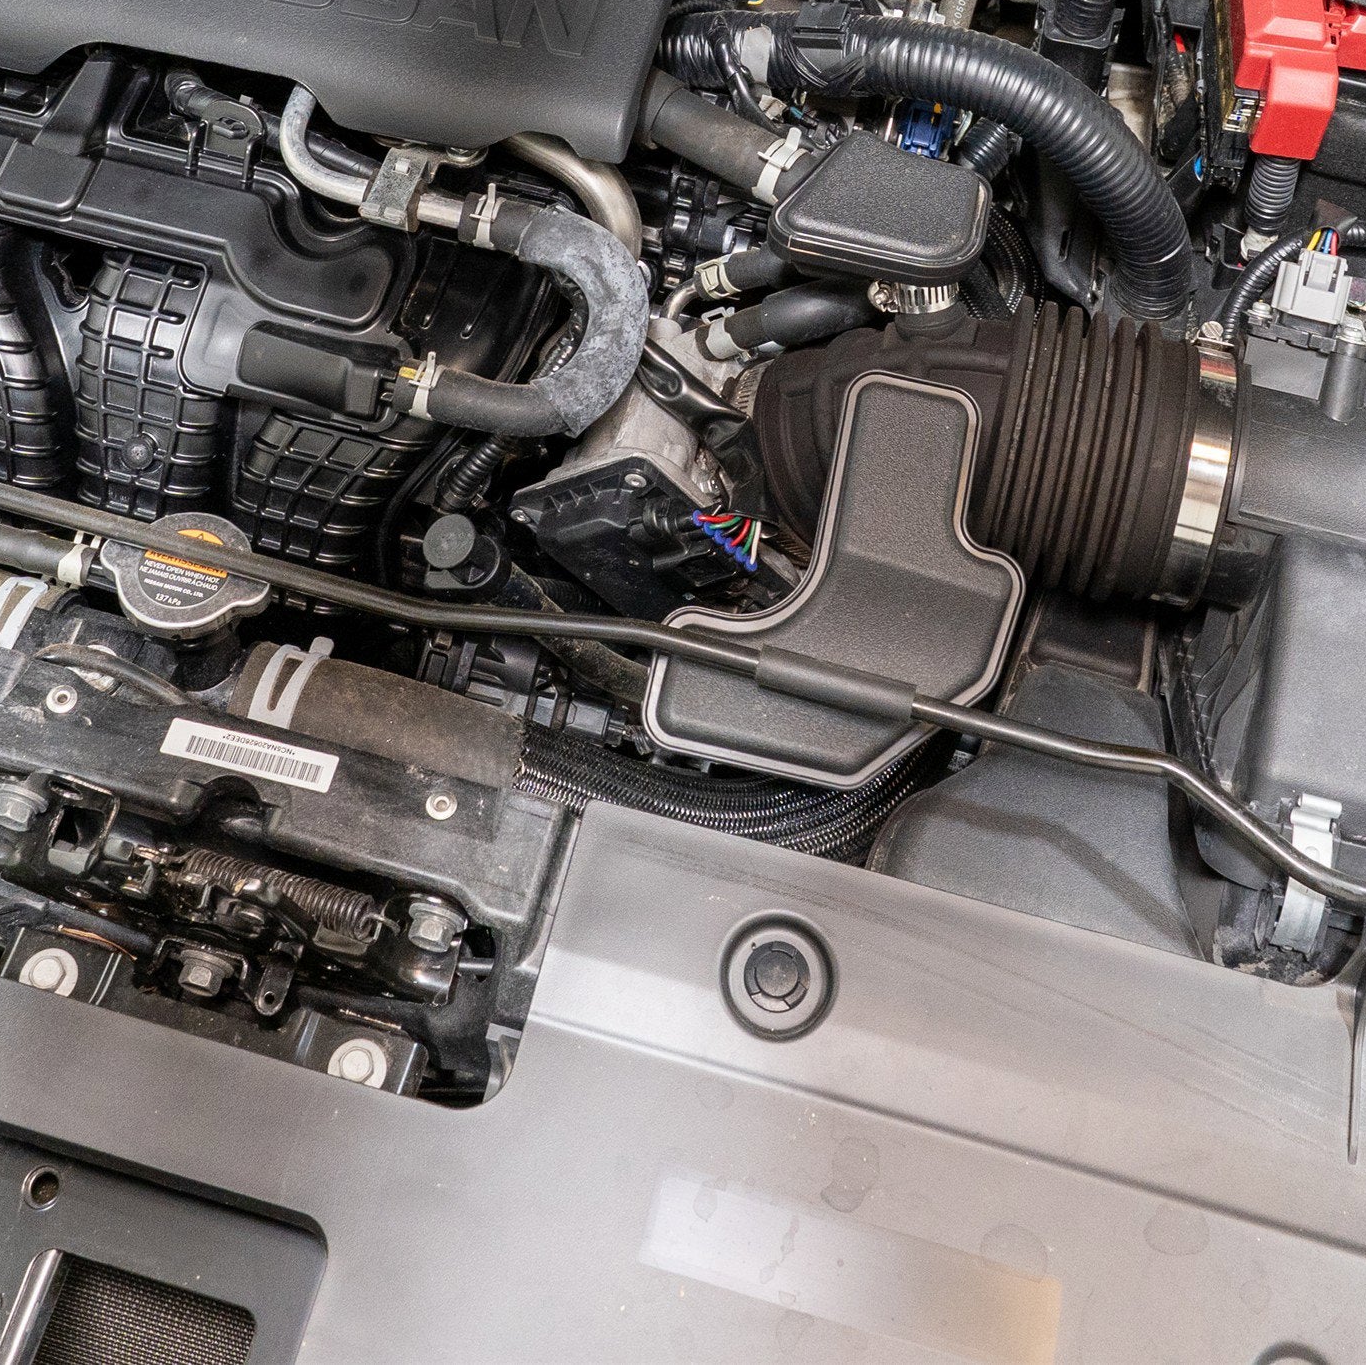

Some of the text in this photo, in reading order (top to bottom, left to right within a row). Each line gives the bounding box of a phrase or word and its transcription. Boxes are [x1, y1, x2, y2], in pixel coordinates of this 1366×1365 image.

[144, 559, 166, 570] NEVER
[166, 564, 185, 575] OPEN
[184, 569, 205, 579] WHEN
[148, 567, 170, 579] JAMAIS
[169, 573, 192, 585] OUVRIR
[143, 578, 164, 588] NISSAN
[163, 582, 183, 593] MOTOR
[155, 592, 182, 606] 137 kPa
